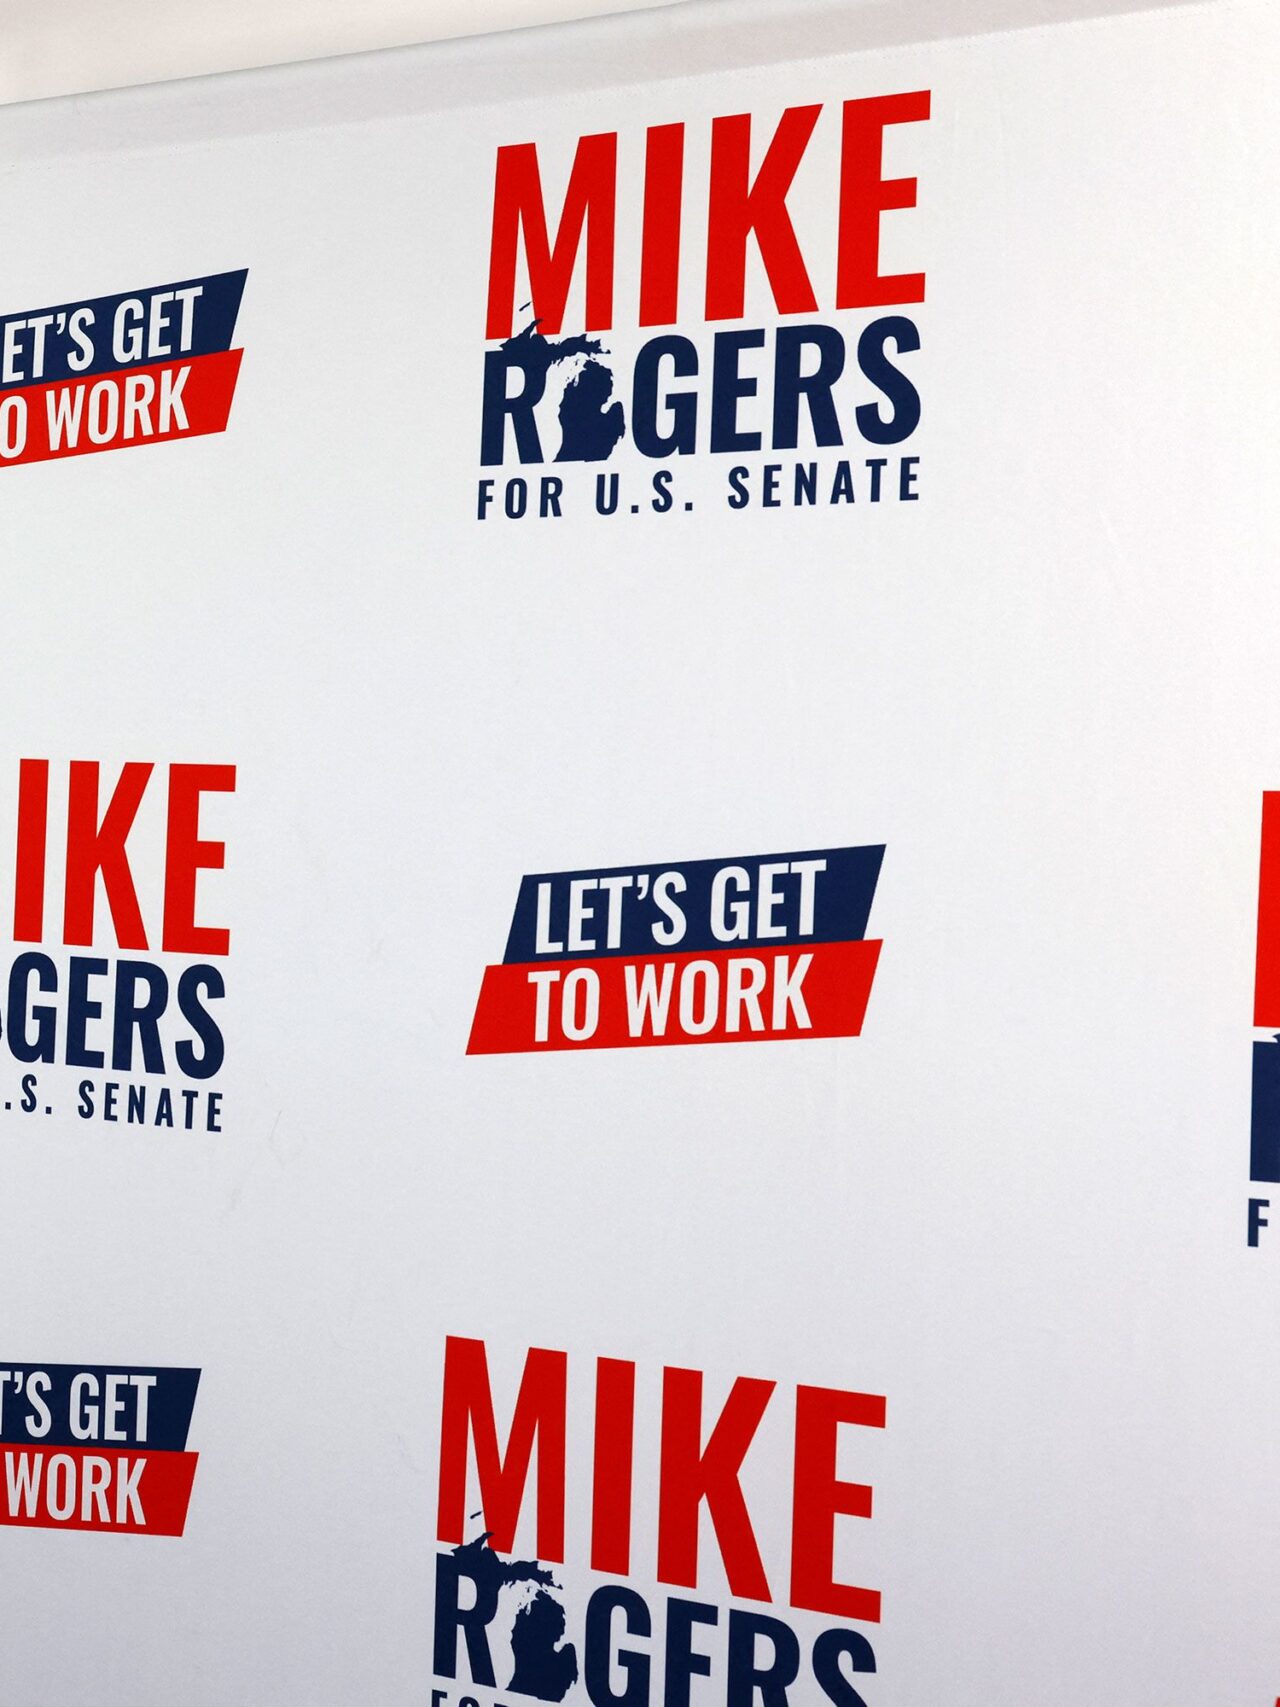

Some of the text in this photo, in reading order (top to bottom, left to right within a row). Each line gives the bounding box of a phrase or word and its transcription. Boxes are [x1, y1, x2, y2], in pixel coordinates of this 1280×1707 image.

[486, 91, 930, 339] MIKE
[112, 286, 204, 364] GET
[45, 365, 192, 452] WORK
[481, 316, 921, 467] ROGERS
[477, 456, 921, 521] FOR U.S. SENATE
[534, 858, 827, 955] LET'S GET
[527, 953, 815, 1043] TO WORK
[77, 1079, 223, 1133] SENATE
[68, 1372, 157, 1442] GET
[4, 1450, 148, 1526] WORK
[437, 1336, 887, 1623] MIKE
